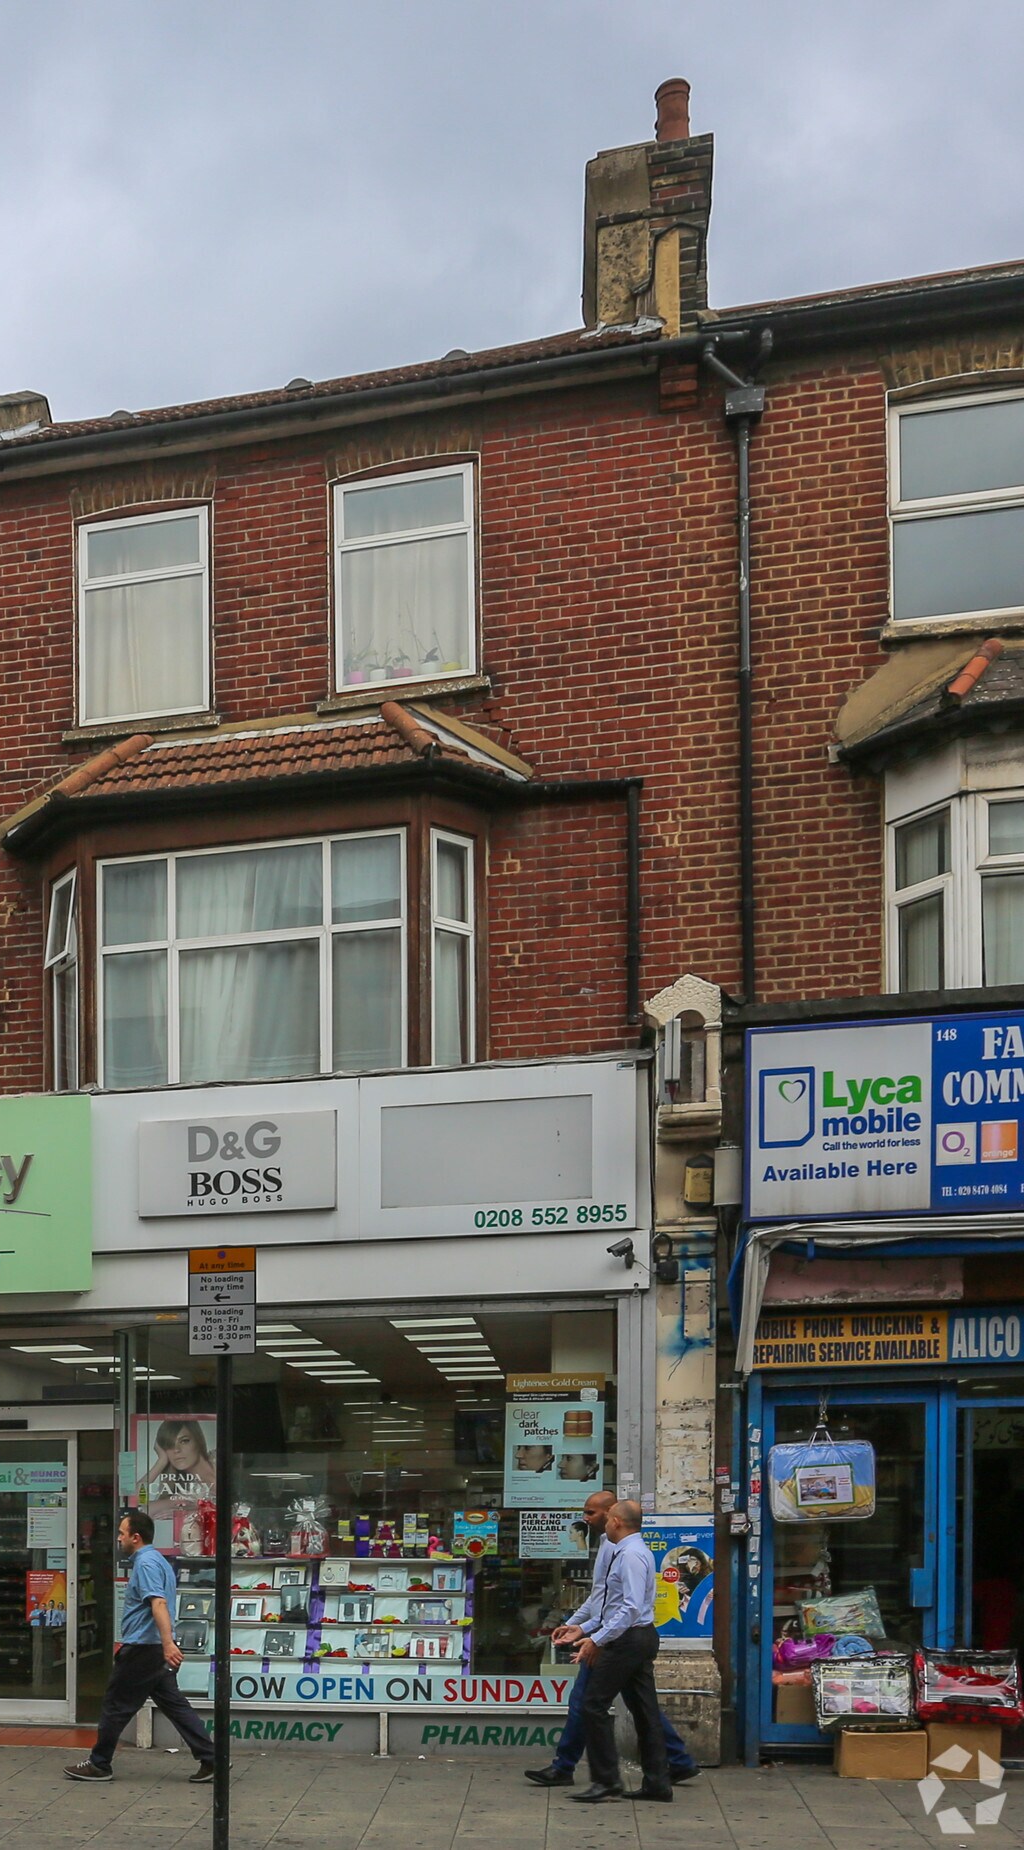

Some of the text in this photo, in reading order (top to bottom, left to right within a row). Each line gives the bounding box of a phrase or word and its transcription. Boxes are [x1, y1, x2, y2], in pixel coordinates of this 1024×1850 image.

[937, 1028, 957, 1041] 148
[822, 1070, 922, 1114] Lyca
[822, 1107, 921, 1137] mobile
[188, 1121, 281, 1162] D&G
[822, 1138, 920, 1151] Call the world for less
[982, 1149, 1014, 1159] orange
[763, 1160, 918, 1182] Available Here
[187, 1167, 282, 1197] BOSS
[942, 1184, 1008, 1196] TEL 020 8470 4084
[187, 1195, 283, 1206] HUGO BOSS
[474, 1204, 627, 1228] 0208 552 8955
[214, 1276, 244, 1284] loading
[210, 1284, 224, 1292] any
[214, 1308, 244, 1316] loading
[803, 1317, 844, 1338] PHONE
[852, 1315, 923, 1337] UNLOCKING
[930, 1317, 940, 1334] &
[219, 1332, 238, 1340] 6.30
[952, 1315, 1020, 1358] ALICO
[753, 1338, 940, 1364] REPAIRING SERVICE AVAILABLE
[551, 1379, 570, 1387] Gold
[513, 1409, 540, 1420] Clear
[519, 1420, 538, 1428] dark
[524, 1427, 558, 1437] patches
[14, 1467, 30, 1486] &
[160, 1473, 201, 1481] PRADA
[149, 1483, 215, 1494] CANDY
[661, 1532, 676, 1540] just
[296, 1676, 374, 1700] OPEN
[386, 1677, 432, 1701] ON
[443, 1678, 568, 1703] SUNDAY
[421, 1725, 564, 1747] PHARMAC
